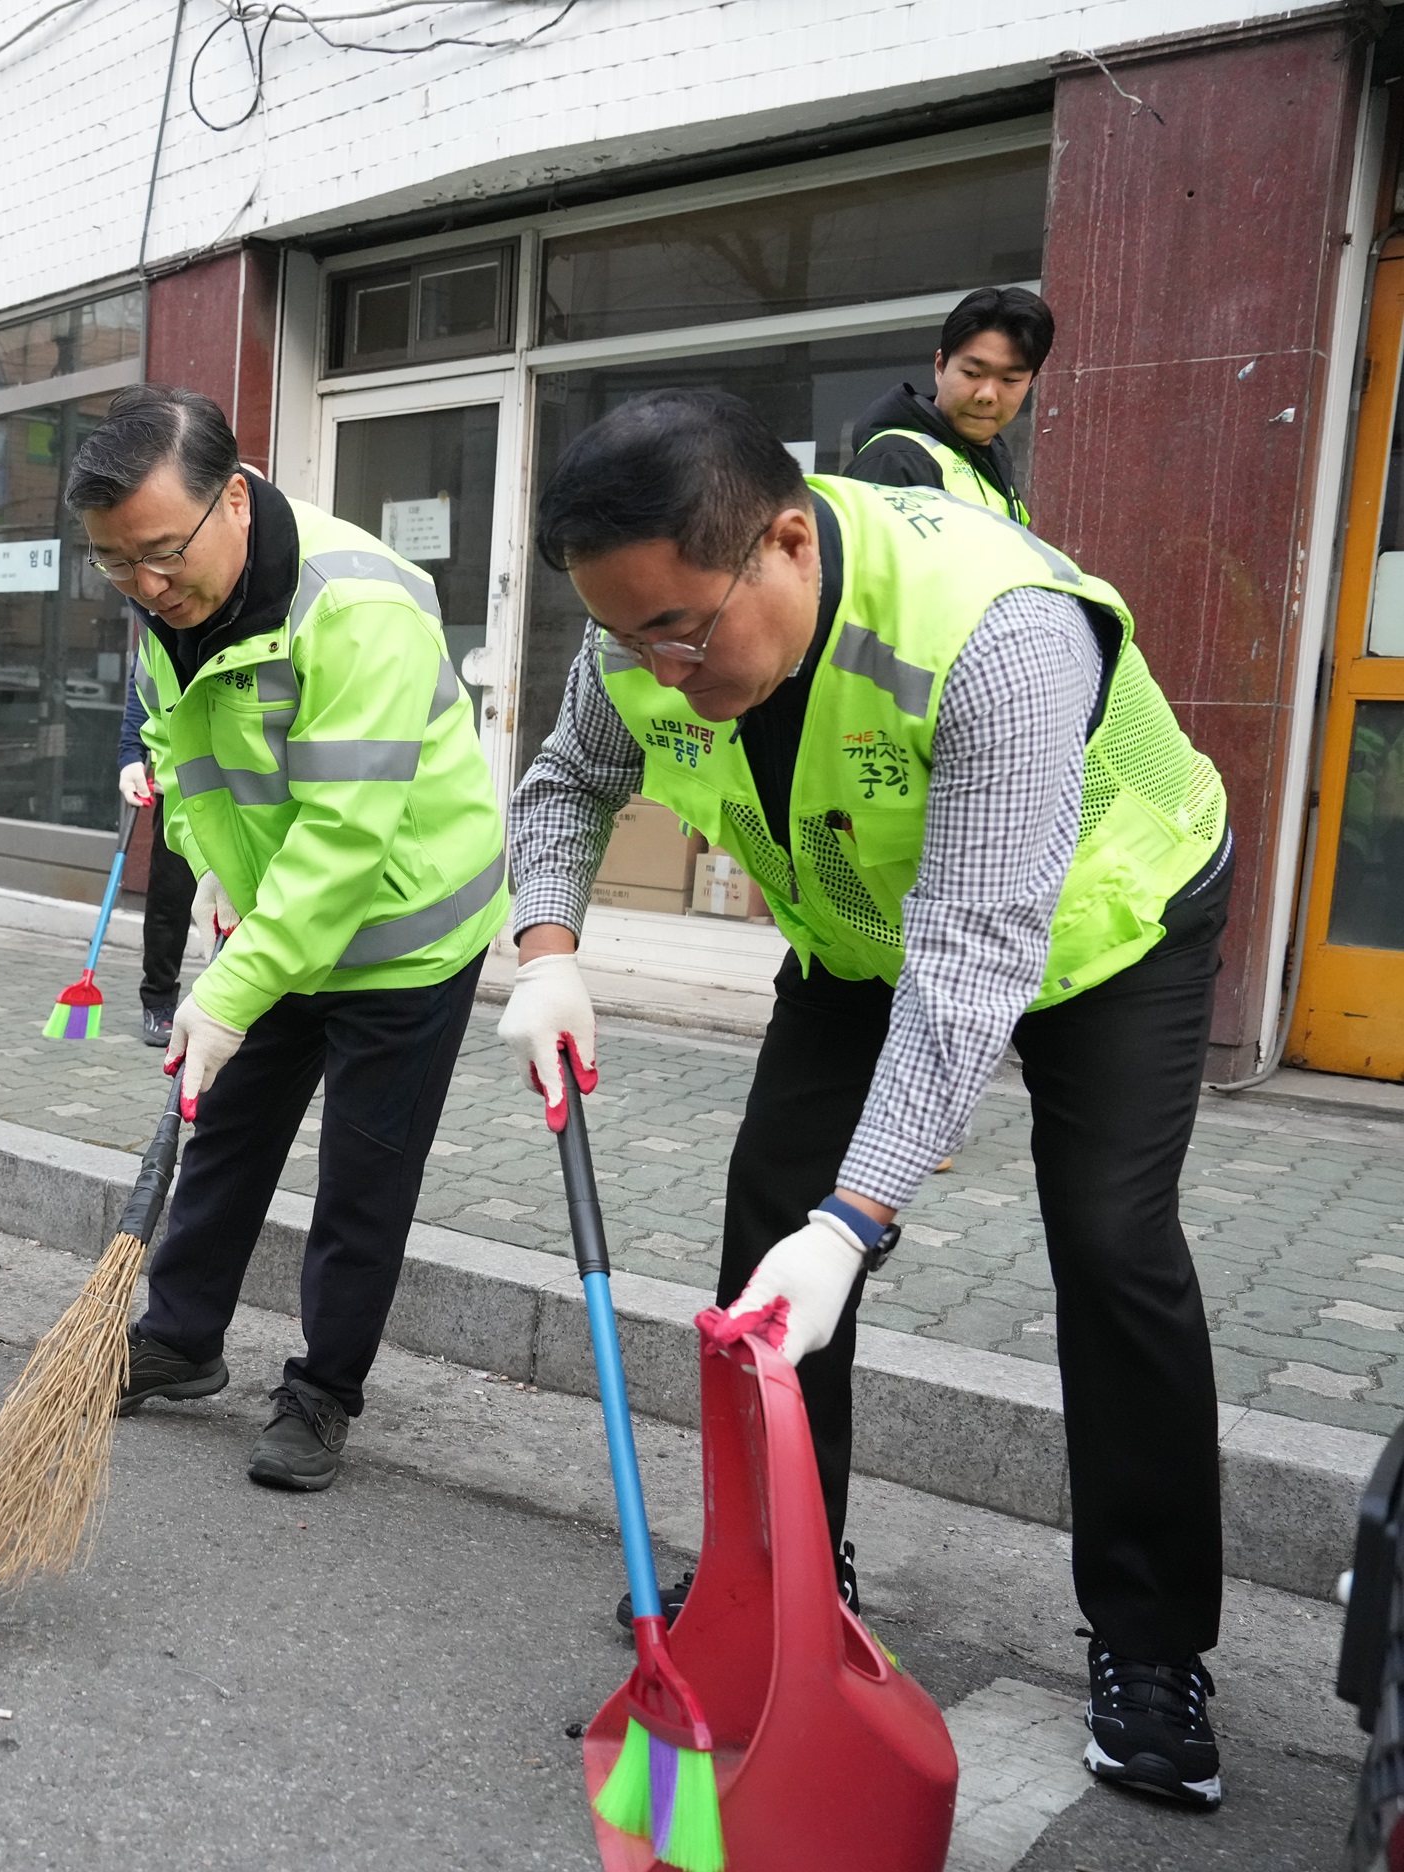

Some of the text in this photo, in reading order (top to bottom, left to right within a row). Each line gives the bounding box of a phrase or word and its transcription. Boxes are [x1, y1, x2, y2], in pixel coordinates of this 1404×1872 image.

[645, 733, 699, 768] 우리 중랑
[651, 719, 715, 755] 나의 자랑
[842, 730, 875, 744] THE
[858, 763, 909, 799] 중랑
